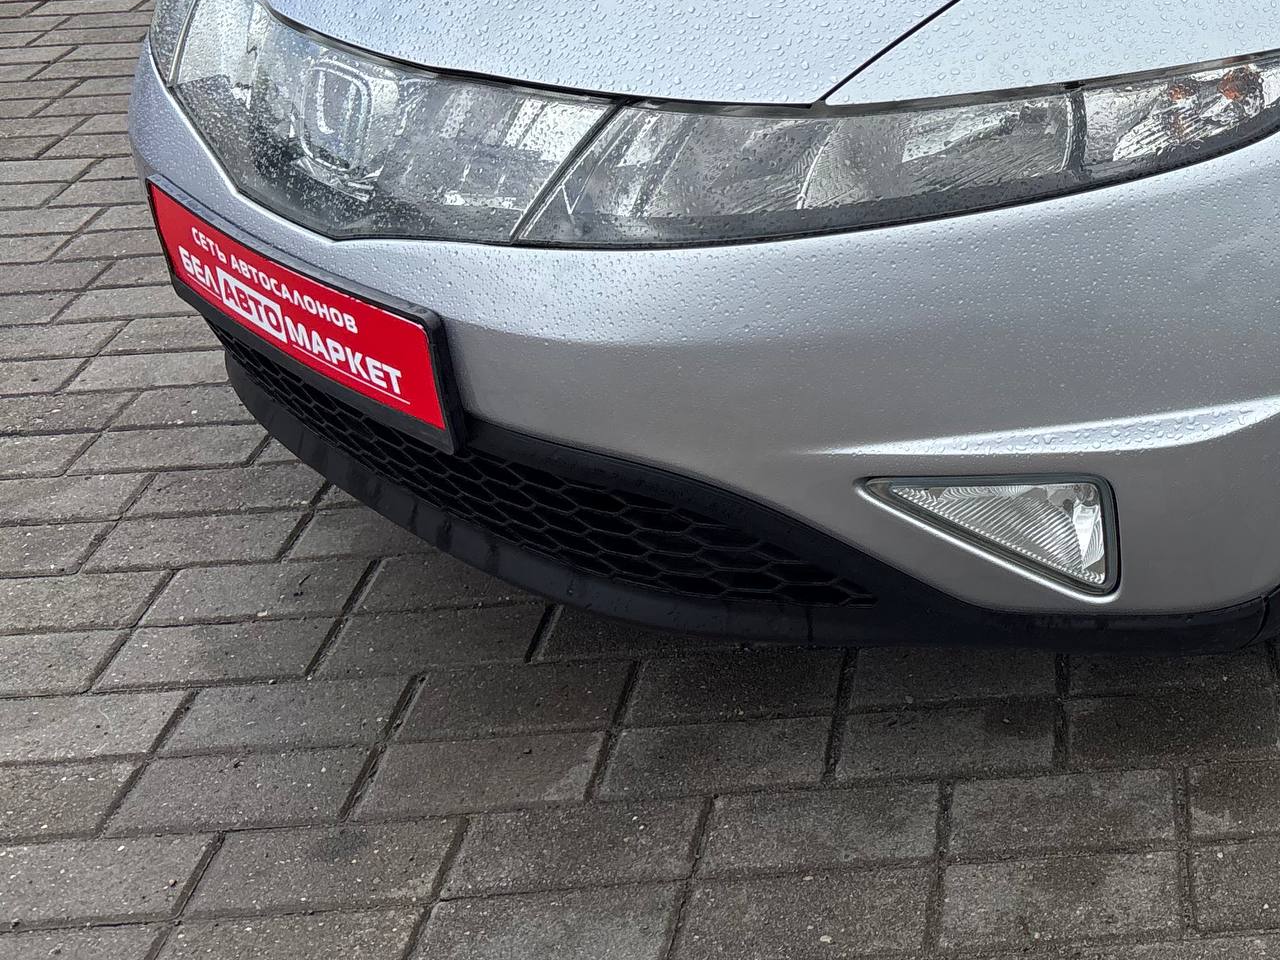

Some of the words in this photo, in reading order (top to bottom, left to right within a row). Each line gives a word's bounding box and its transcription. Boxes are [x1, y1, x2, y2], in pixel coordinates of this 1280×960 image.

[178, 245, 402, 394] БЕЛАВТОМАРКЕТ
[191, 226, 227, 263] СЕТЬ
[230, 256, 360, 334] АВТОСАЛОНОВ
